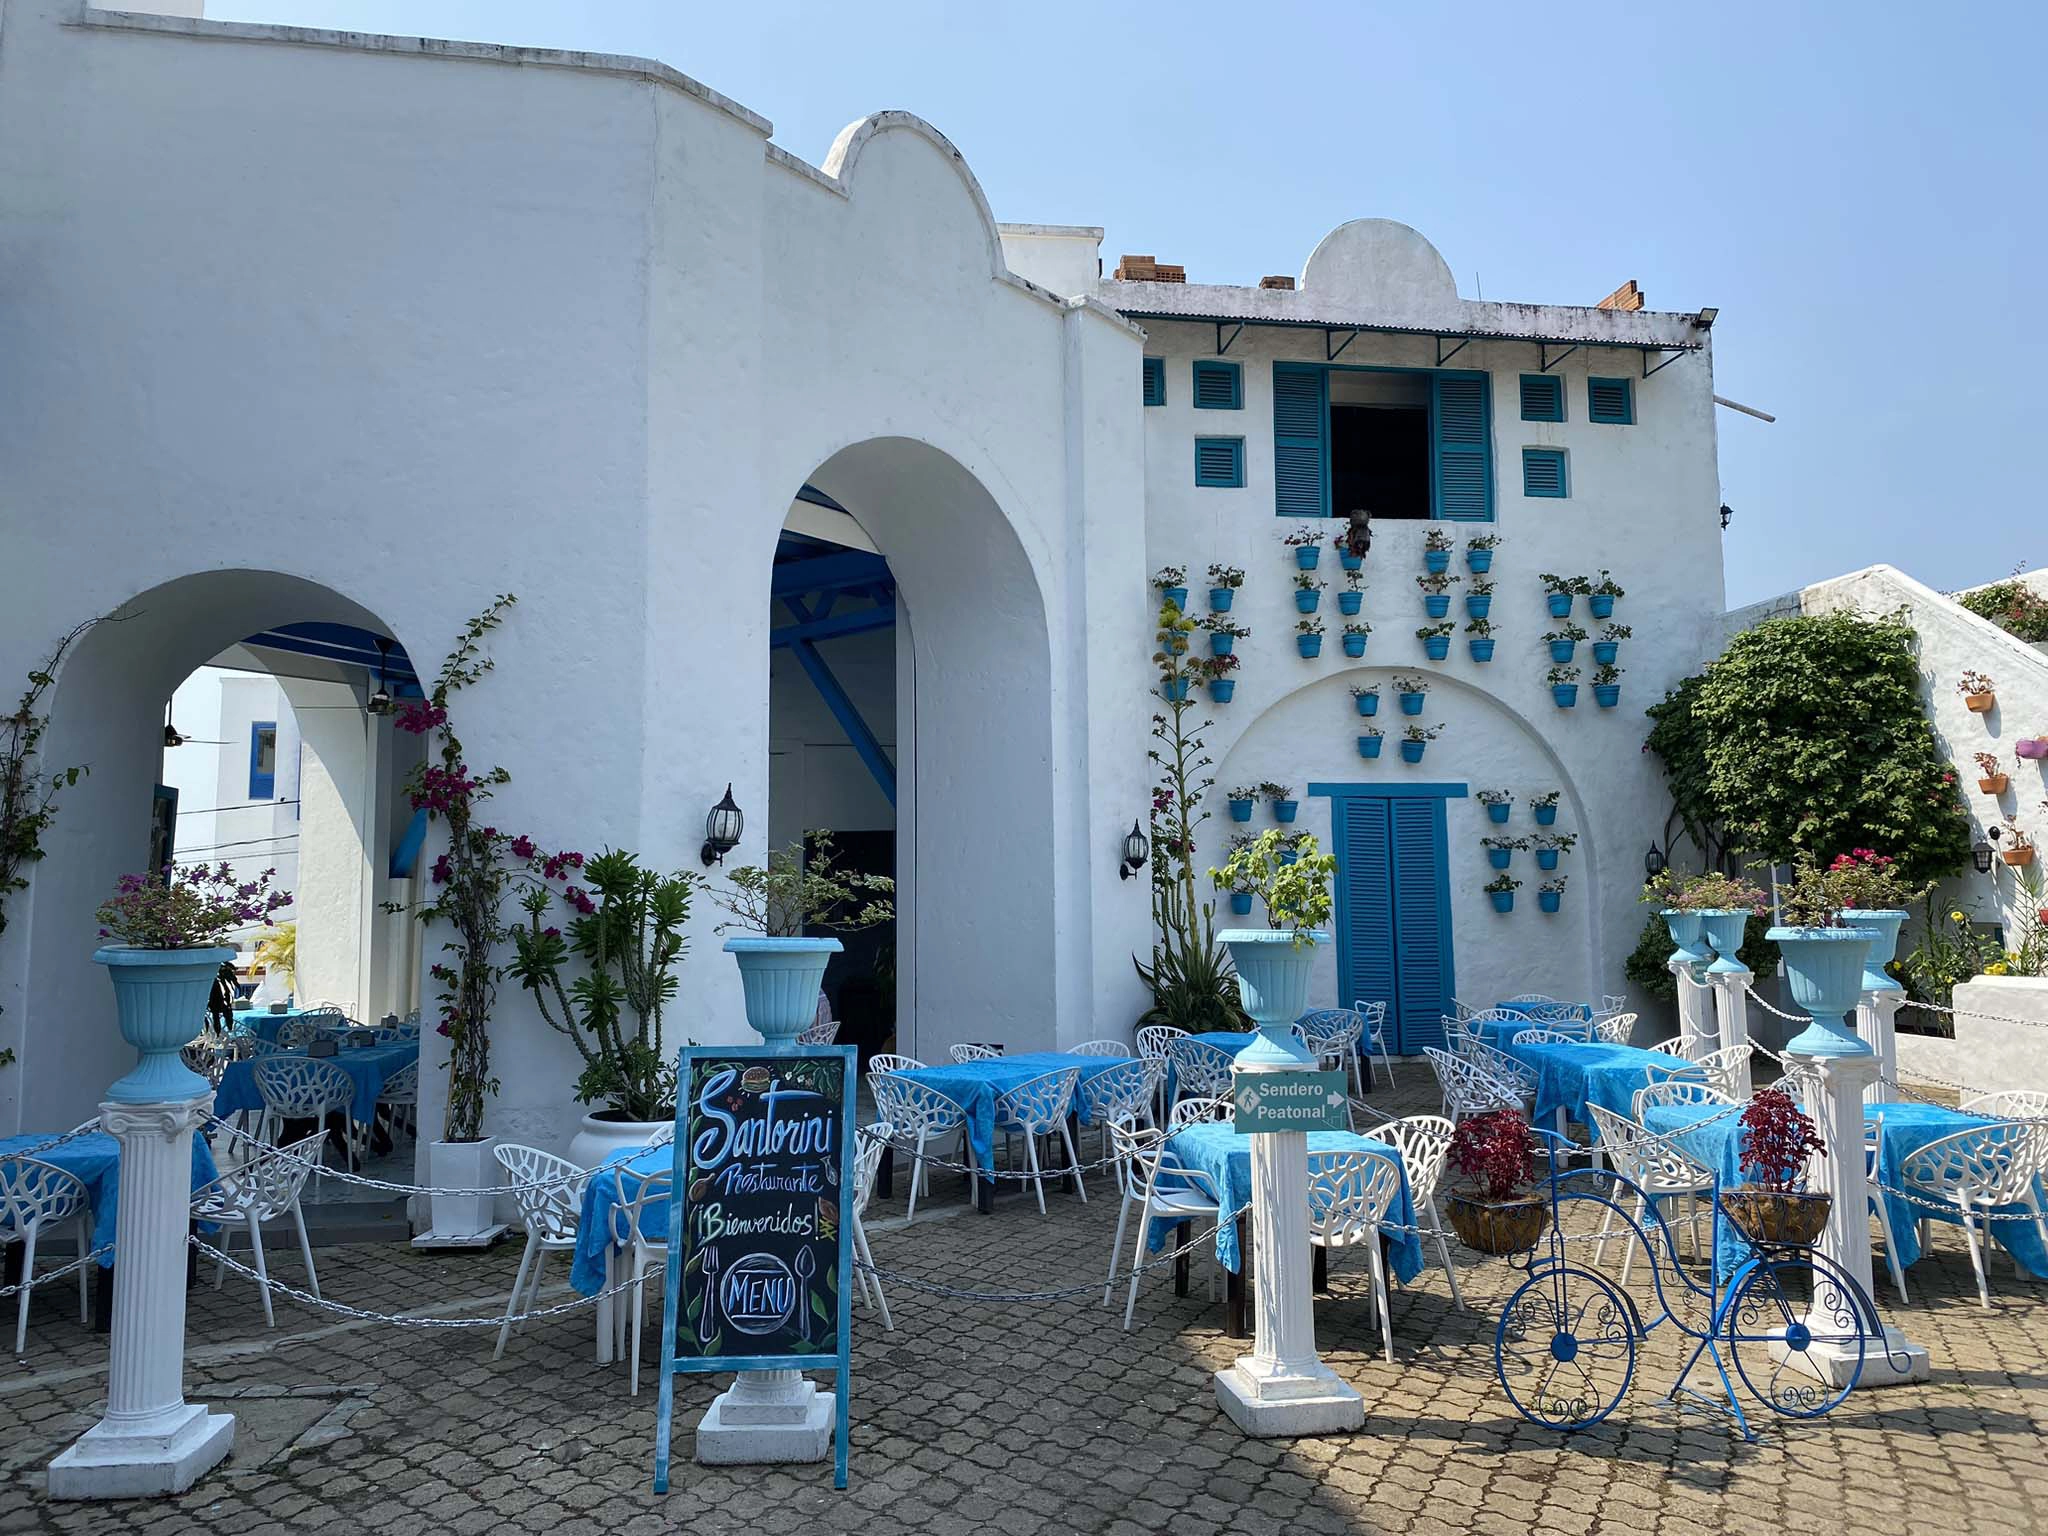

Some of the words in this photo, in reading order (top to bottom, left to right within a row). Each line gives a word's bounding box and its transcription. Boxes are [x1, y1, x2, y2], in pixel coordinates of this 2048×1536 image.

[1259, 1082, 1324, 1097] Sendero
[692, 1069, 833, 1169] Santorini
[1257, 1104, 1325, 1119] Peatonal
[714, 1162, 824, 1196] Restaurante
[728, 1274, 792, 1315] MENU
